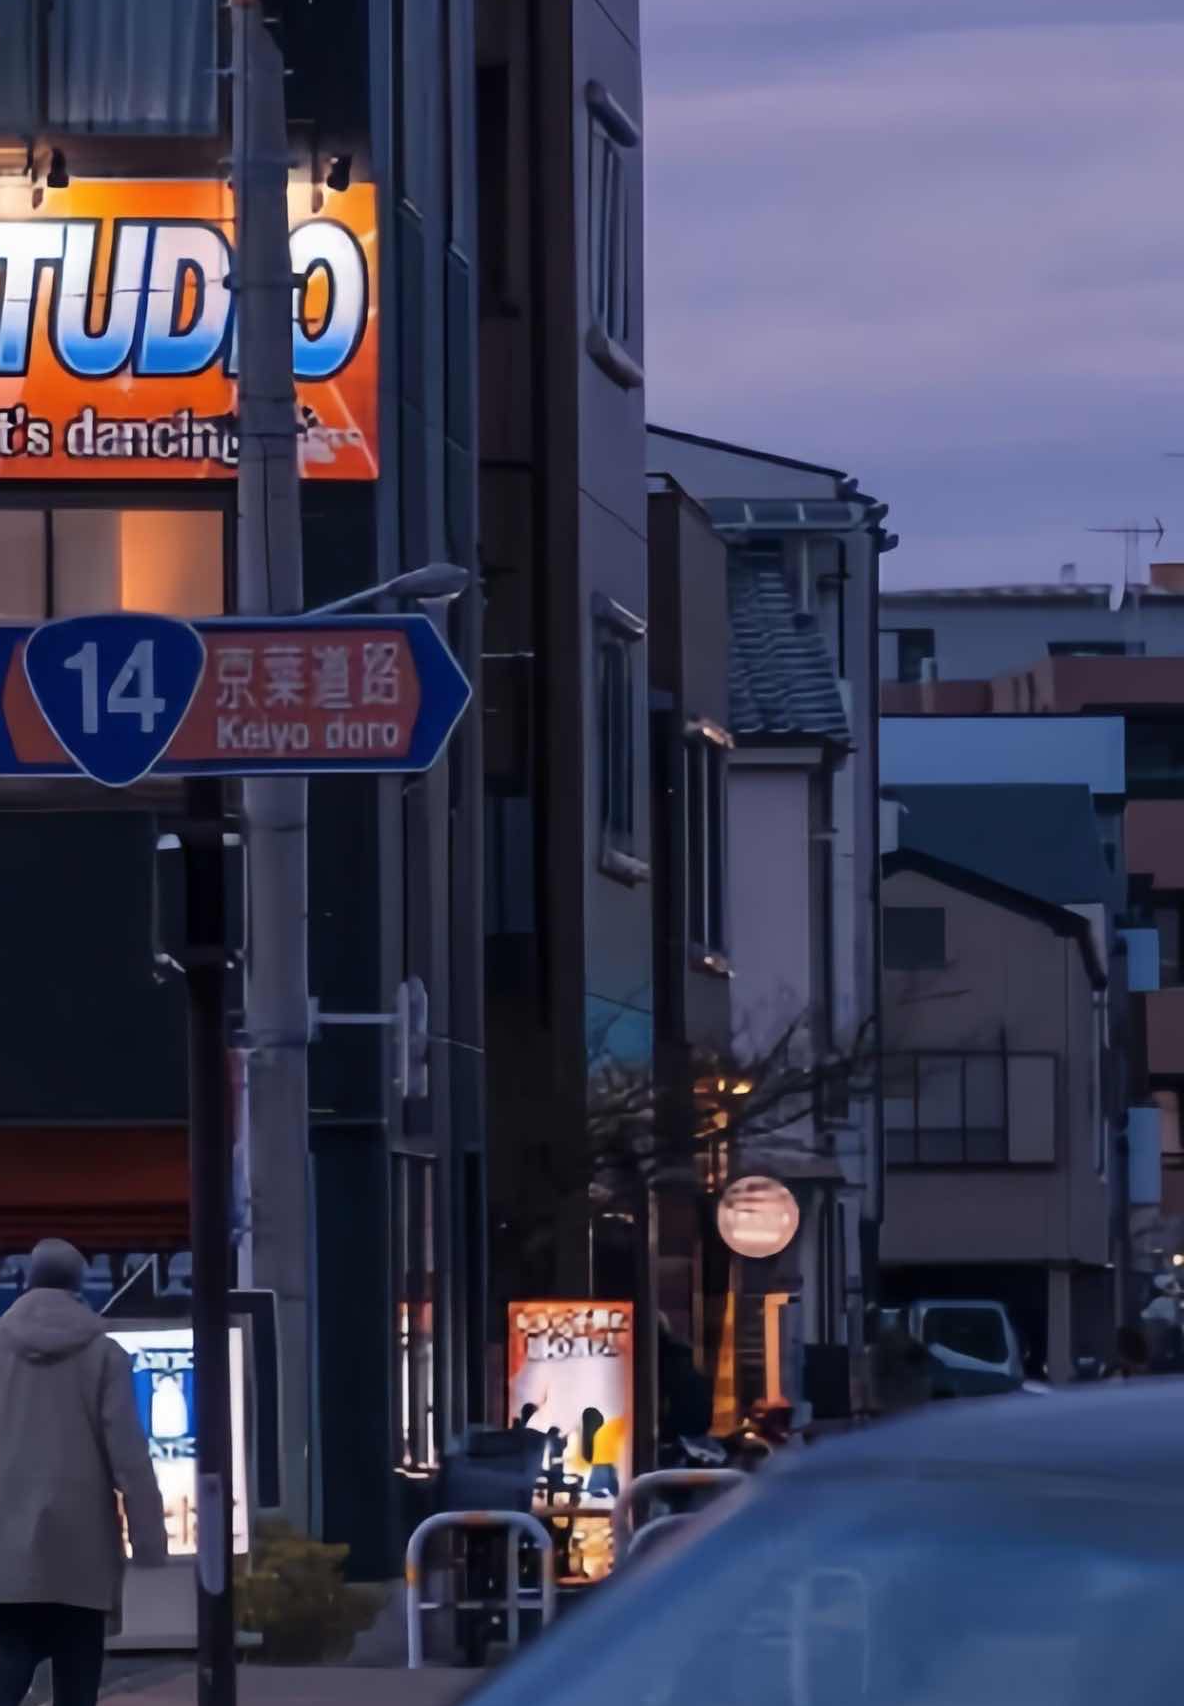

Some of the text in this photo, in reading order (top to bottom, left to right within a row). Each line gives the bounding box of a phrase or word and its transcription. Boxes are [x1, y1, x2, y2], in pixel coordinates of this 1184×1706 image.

[63, 640, 166, 734] 14
[216, 642, 400, 709] 京葉道路
[216, 714, 399, 756] Keiyo doro
